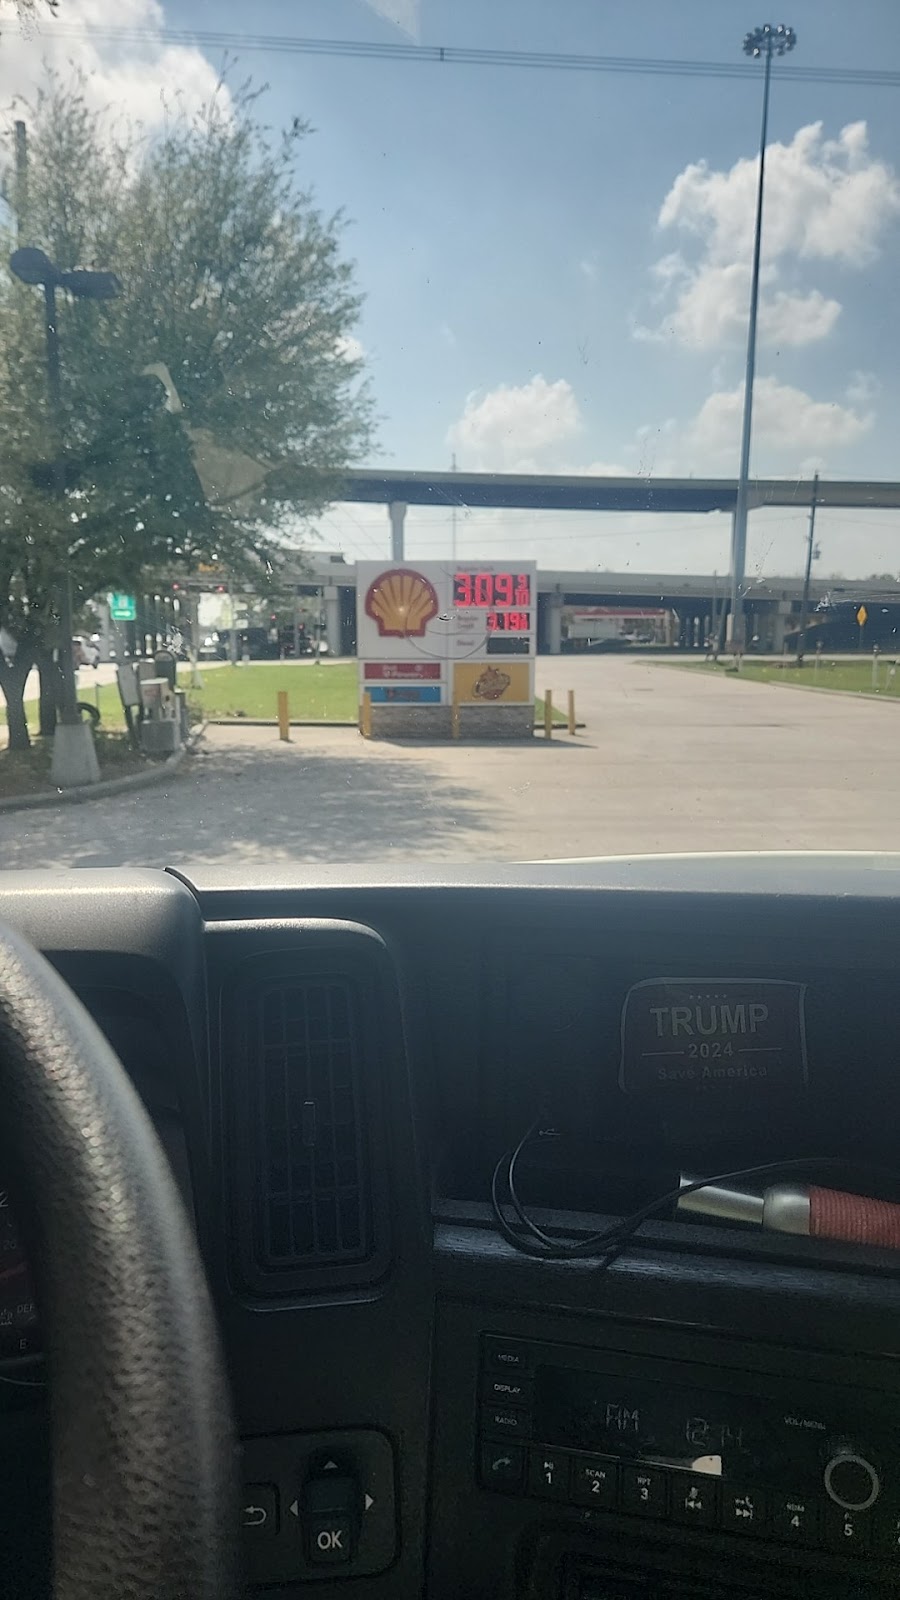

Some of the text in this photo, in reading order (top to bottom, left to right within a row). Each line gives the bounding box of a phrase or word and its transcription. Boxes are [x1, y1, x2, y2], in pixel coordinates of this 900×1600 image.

[649, 1003, 769, 1038] TRUMP
[688, 1041, 734, 1059] 2024
[656, 1065, 768, 1081] Save America
[19, 1338, 27, 1350] E
[498, 1353, 520, 1364] MEDIA
[493, 1383, 522, 1394] DISPLAY
[494, 1415, 518, 1427] RADIO
[545, 1472, 552, 1484] 1
[585, 1468, 606, 1479] SCAN
[591, 1480, 600, 1493] 2
[640, 1488, 649, 1500] 3
[790, 1515, 800, 1528] 4
[844, 1523, 854, 1536] 5
[317, 1529, 343, 1550] OK
